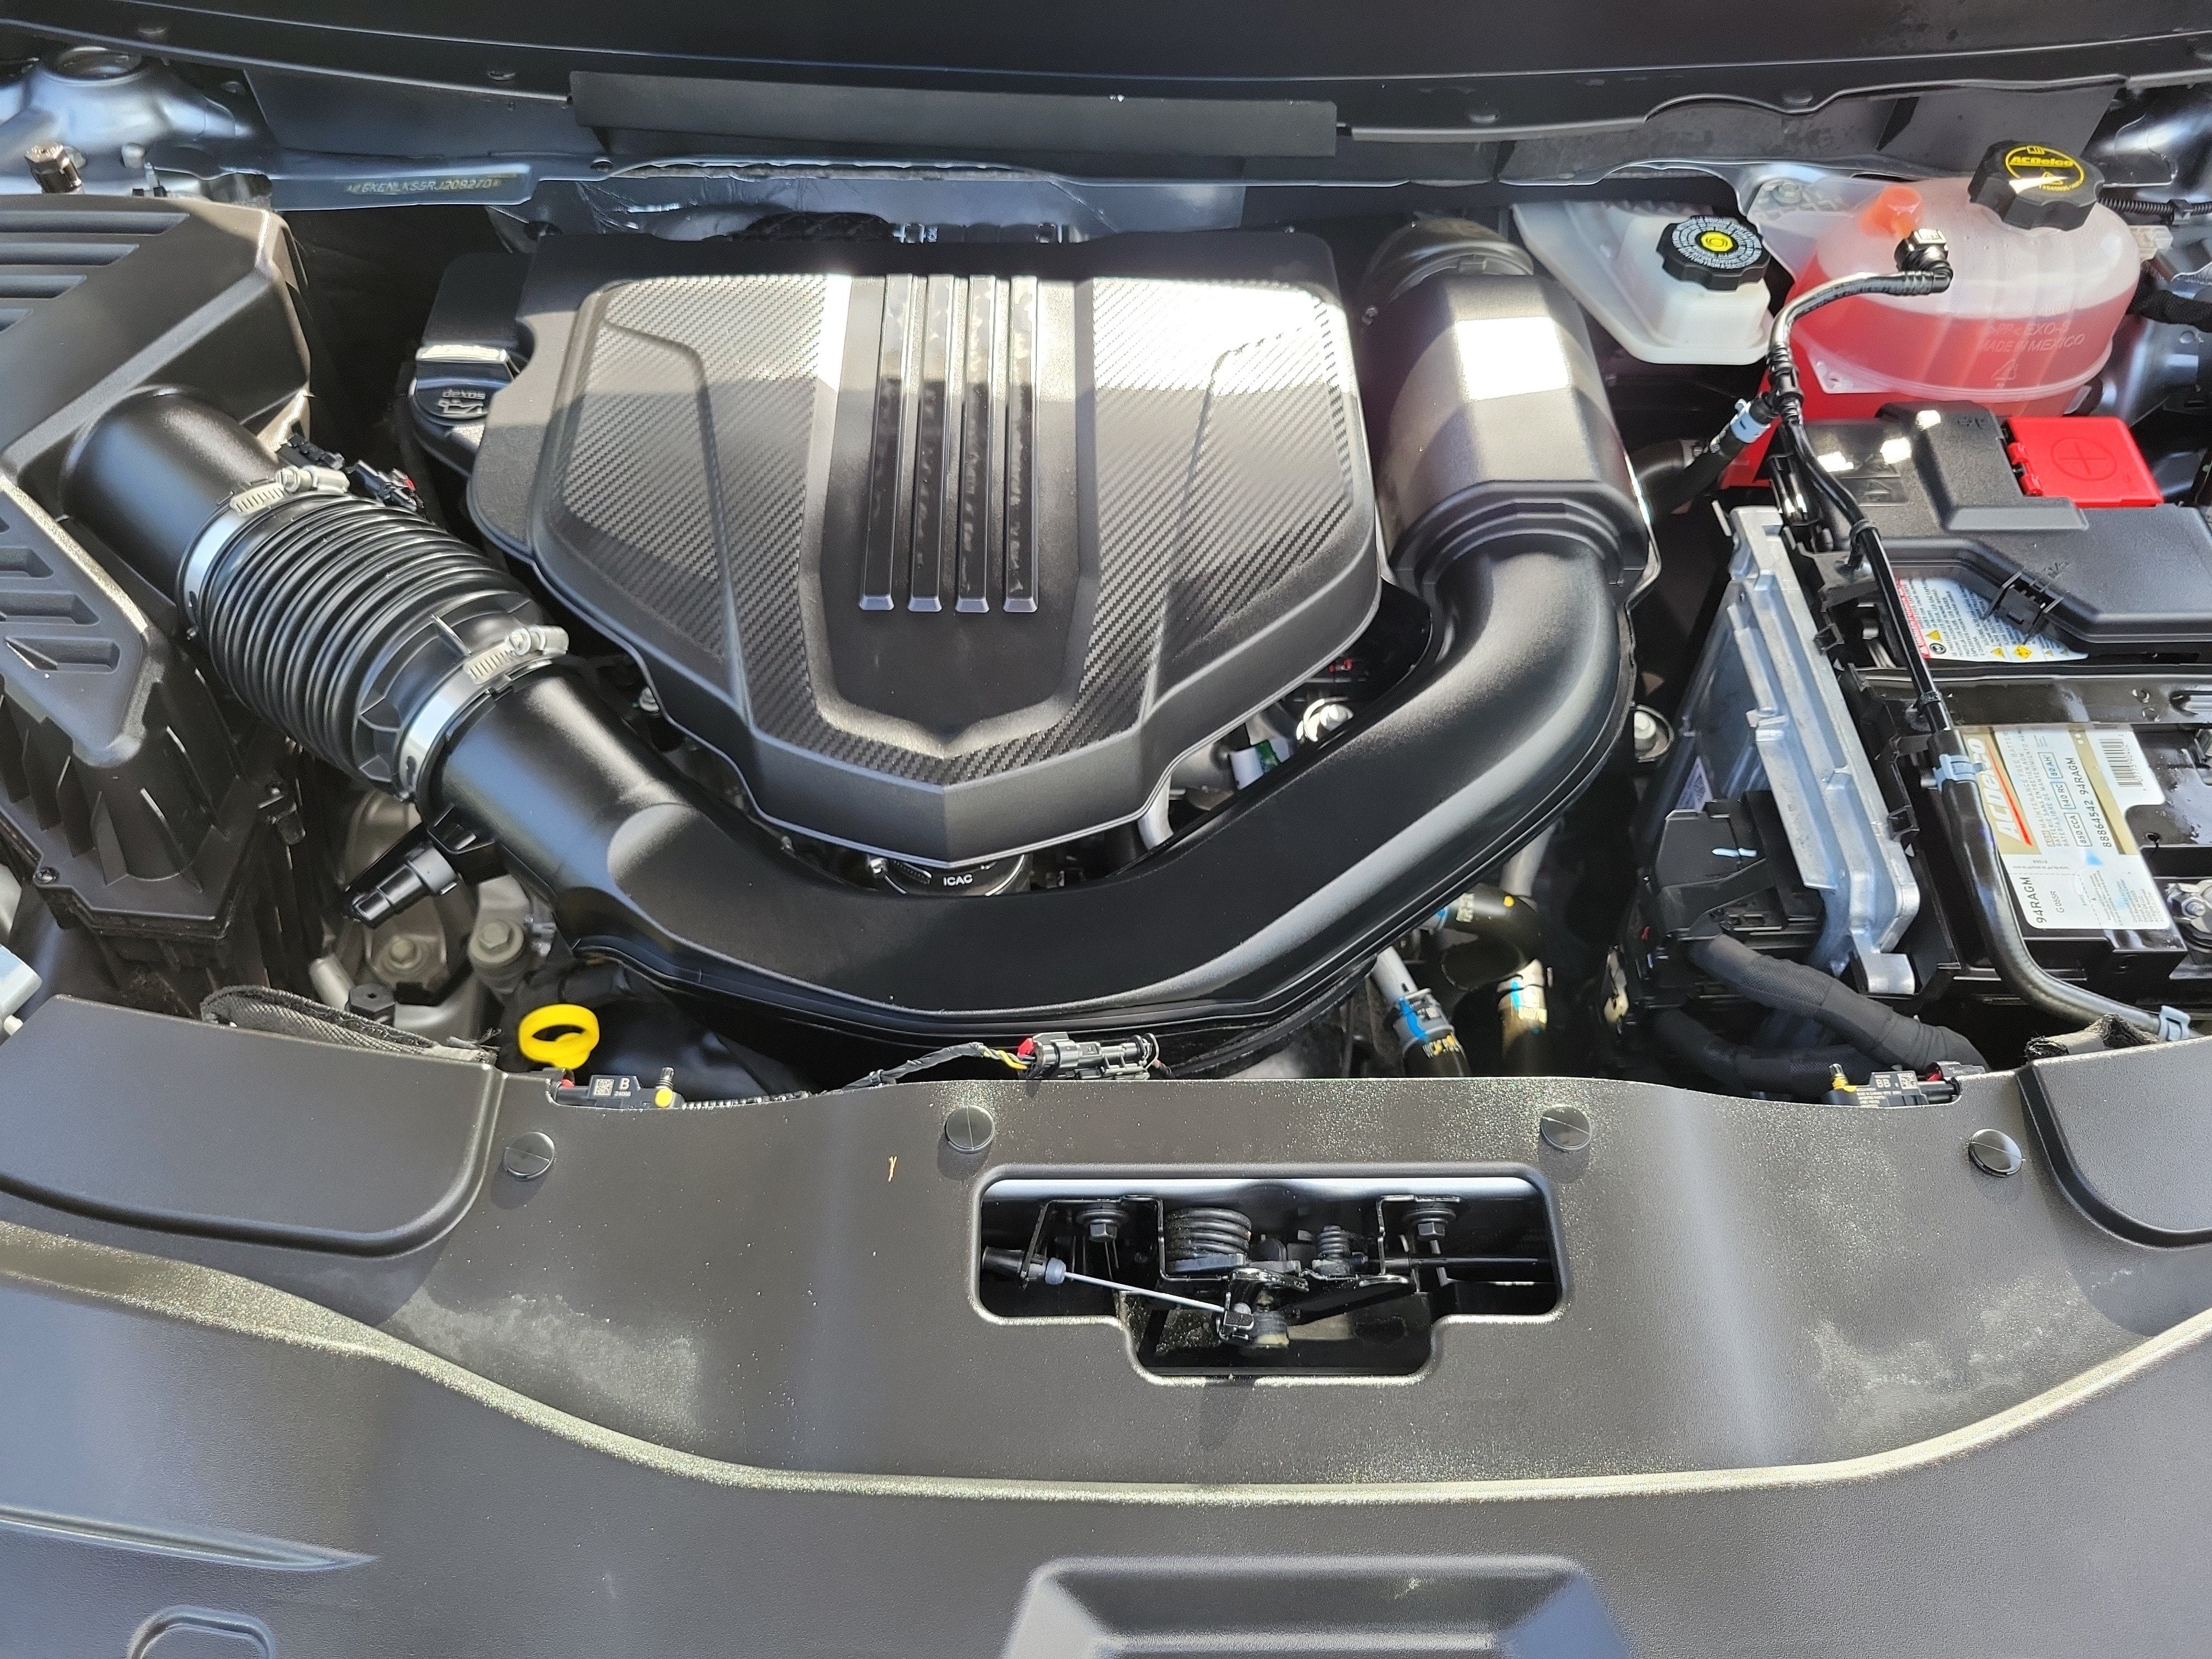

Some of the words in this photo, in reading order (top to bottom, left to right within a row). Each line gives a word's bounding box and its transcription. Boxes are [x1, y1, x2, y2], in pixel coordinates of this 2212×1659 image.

[2010, 156, 2073, 167] ACDelco
[2027, 334, 2085, 352] MEXICO
[442, 389, 486, 400] dexos
[2049, 768, 2058, 776] 80
[2064, 758, 2089, 795] 94RAGM
[2056, 784, 2065, 793] RC
[2061, 795, 2070, 806] 140
[2069, 815, 2080, 829] CCA
[2084, 800, 2112, 847] 88864542
[2076, 831, 2086, 844] 850
[943, 873, 974, 887] ICAC
[2019, 877, 2047, 923] 94RAGM
[619, 1077, 630, 1091] B
[1875, 1079, 1891, 1088] BB
